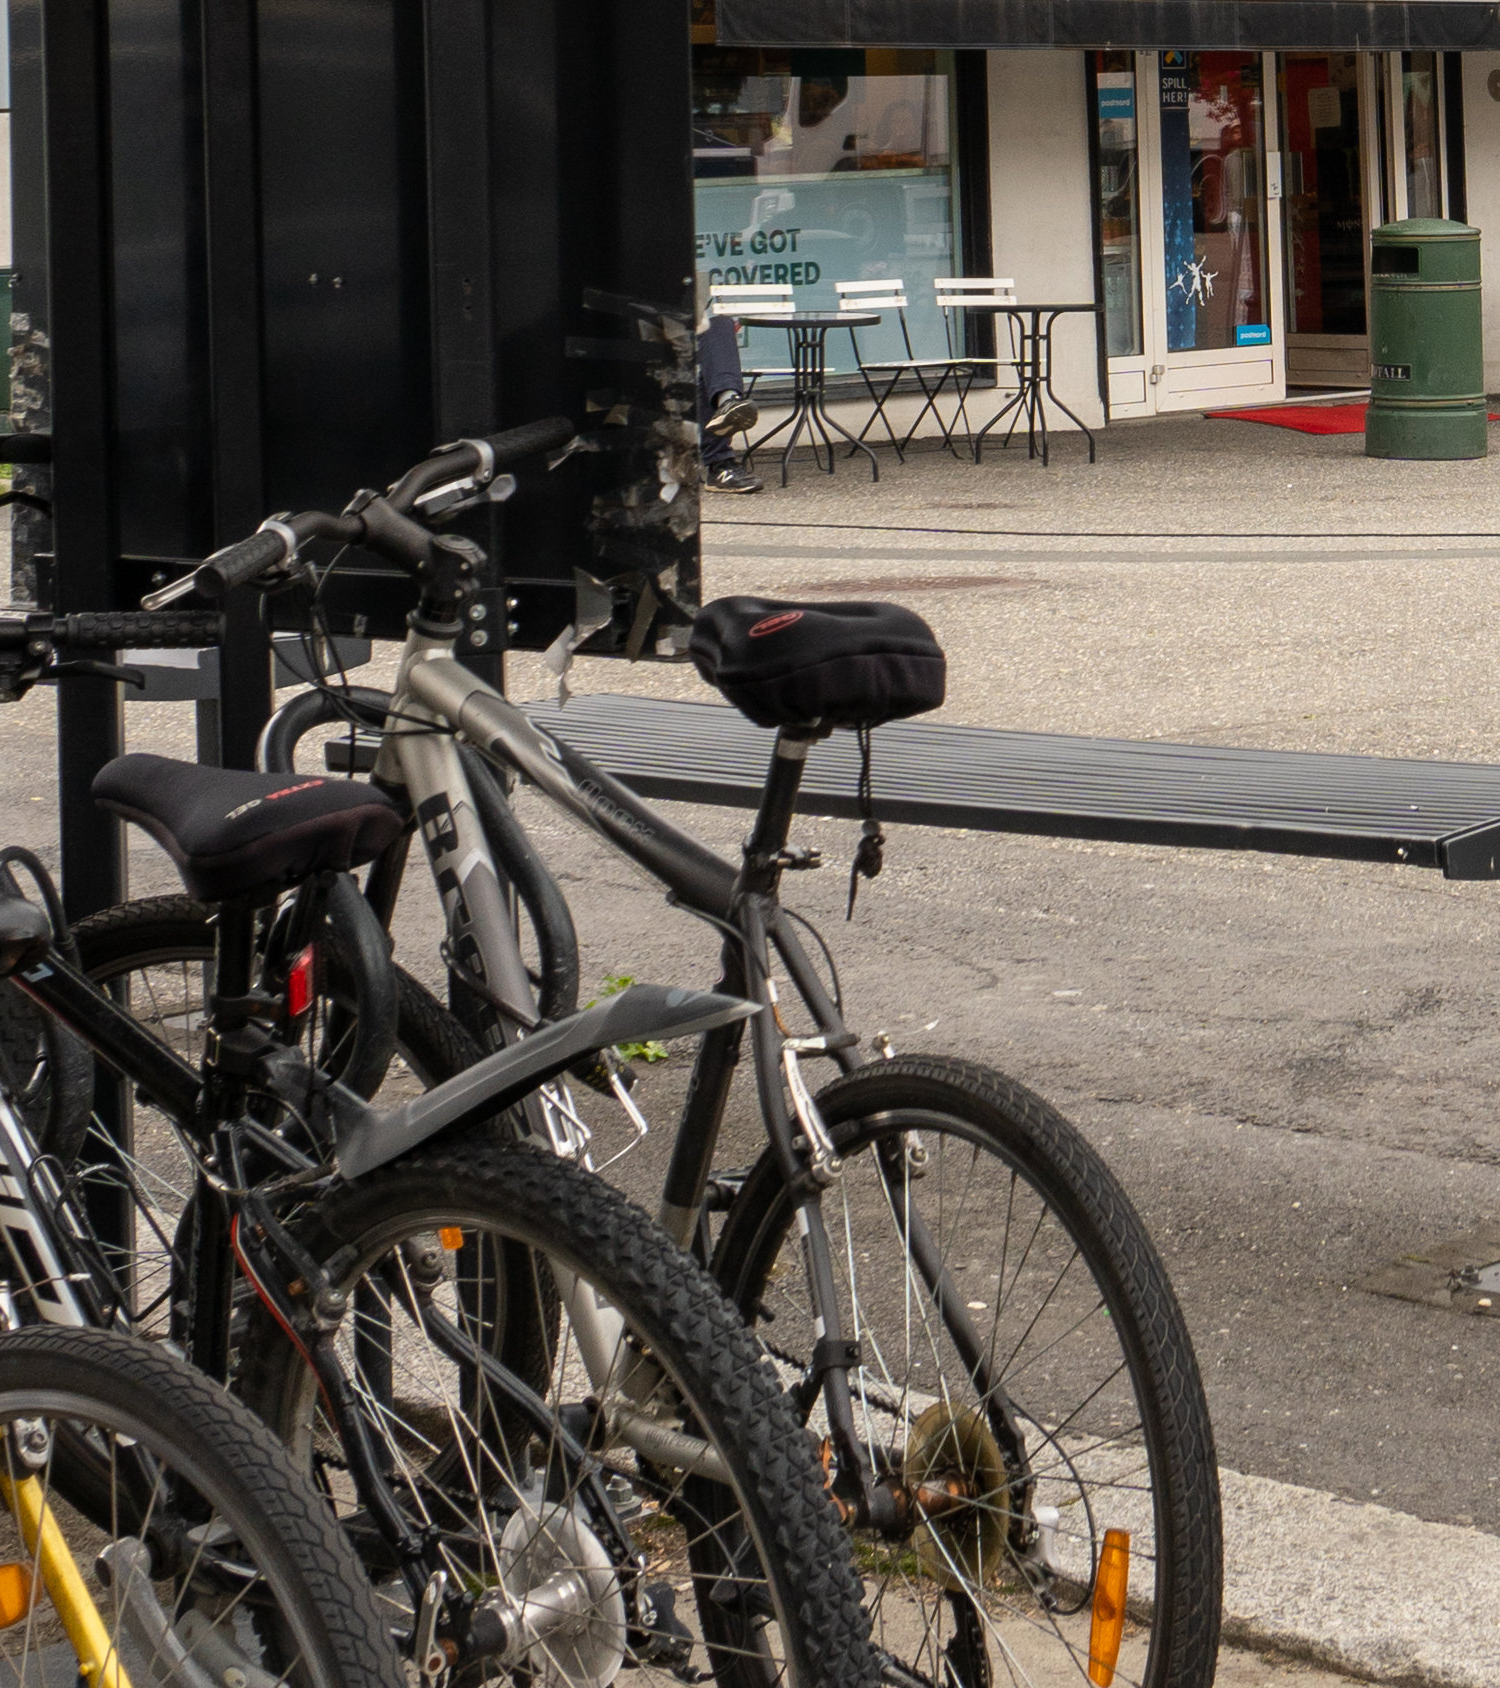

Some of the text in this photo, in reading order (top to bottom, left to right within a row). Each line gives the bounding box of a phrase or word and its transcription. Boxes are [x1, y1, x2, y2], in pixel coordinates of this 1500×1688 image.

[1162, 77, 1187, 90] SPILL
[1162, 91, 1187, 103] HER!
[695, 228, 801, 259] E'VE GOT
[708, 261, 821, 286] COVERED
